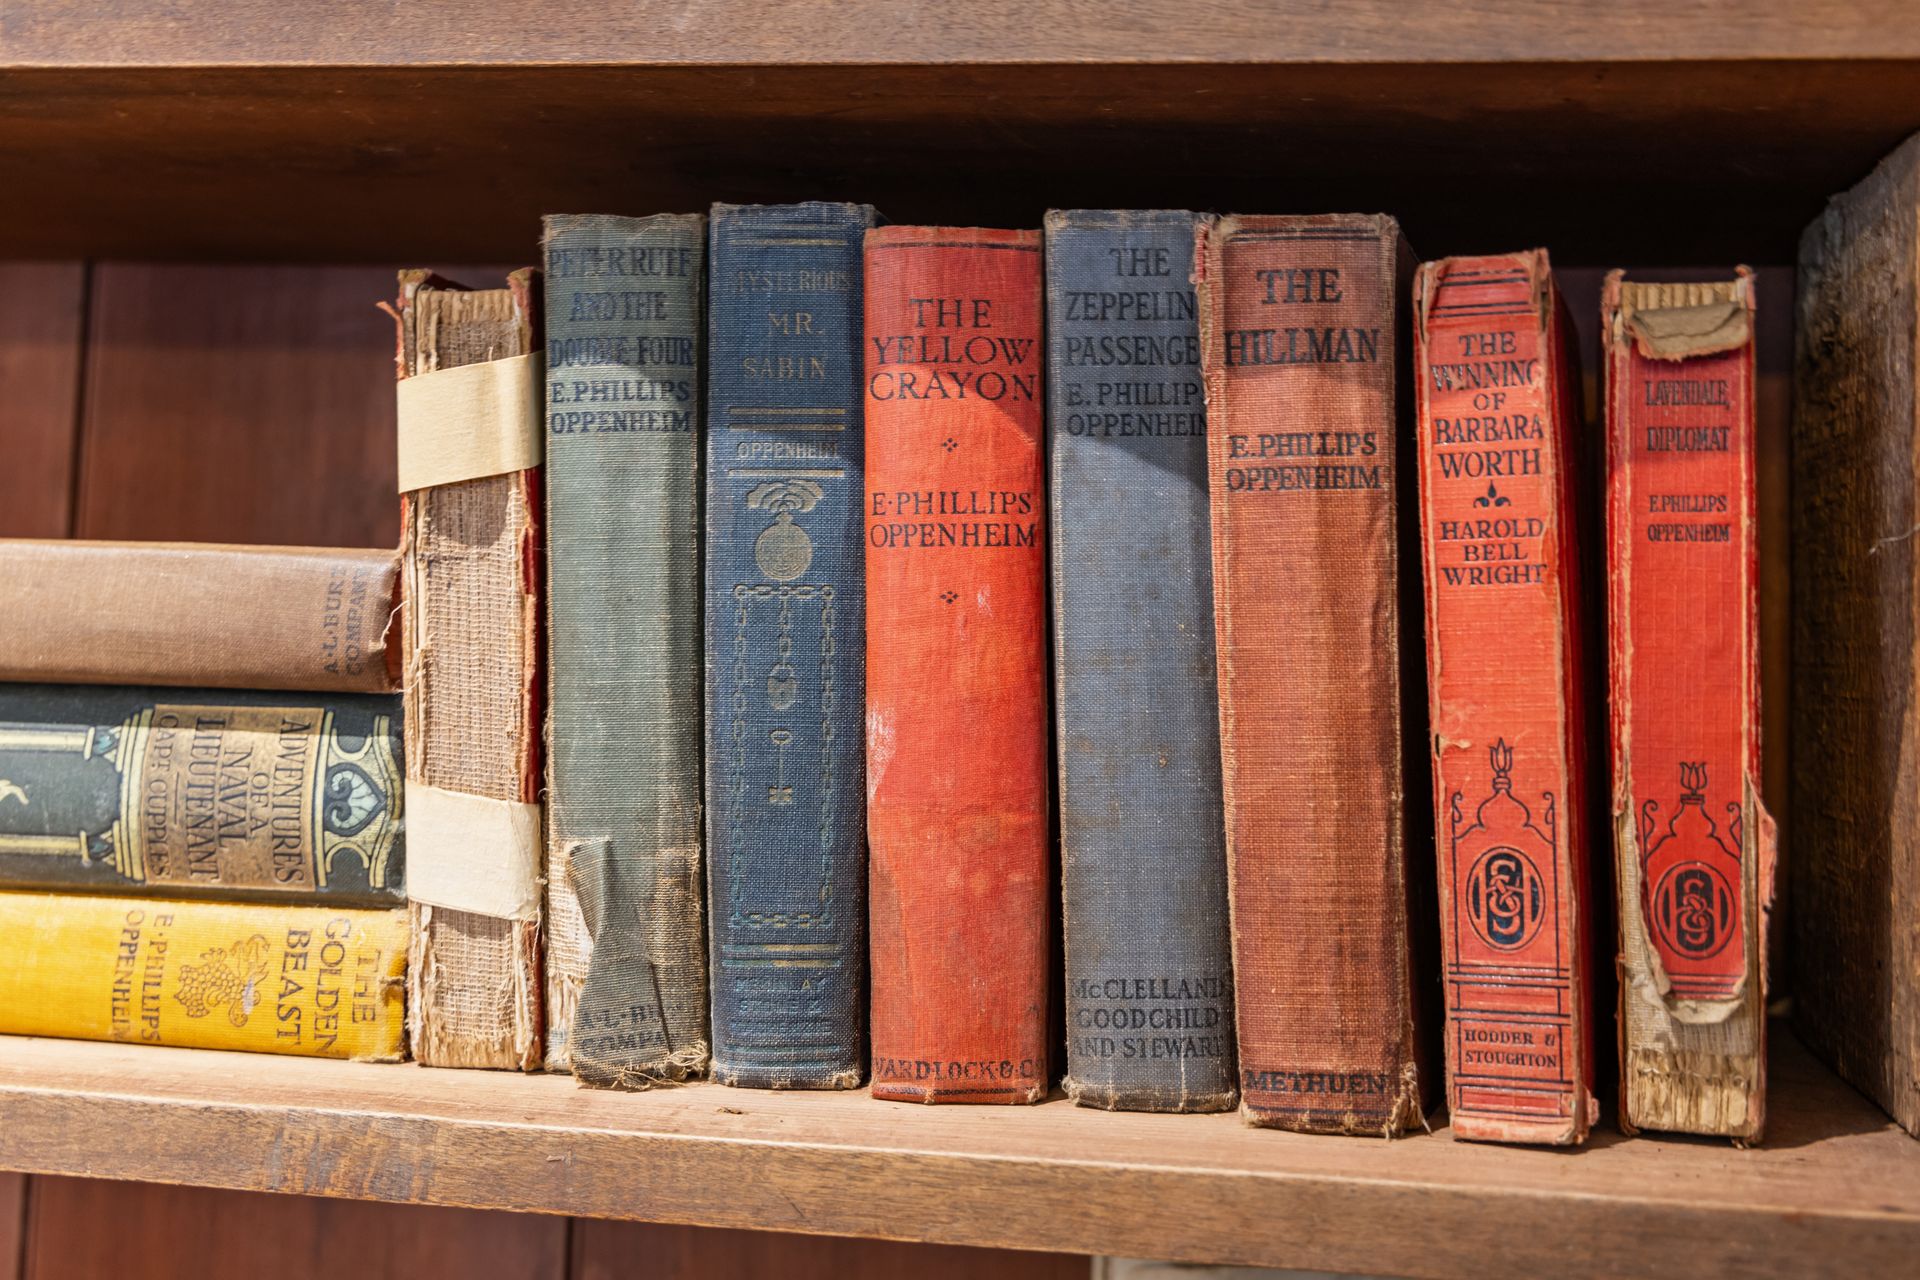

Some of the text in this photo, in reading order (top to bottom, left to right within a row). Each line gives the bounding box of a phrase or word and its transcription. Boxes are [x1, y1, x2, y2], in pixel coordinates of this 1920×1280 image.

[1109, 248, 1171, 277] THE
[1257, 269, 1343, 305] THE
[570, 292, 666, 321] AND THE
[909, 298, 992, 328] THE
[1065, 291, 1197, 321] ZEPPELIN
[872, 336, 1035, 365] YELLOW
[1064, 335, 1200, 366] PASSENGE
[1225, 328, 1381, 366] HILLMAN
[1458, 331, 1517, 356] THE
[743, 357, 826, 380] SABIN
[869, 371, 1036, 400] CRAYON
[1096, 382, 1202, 406] PHILLIP
[1473, 392, 1506, 411] OF
[551, 410, 691, 433] OPPENHEIM
[1434, 414, 1544, 444] BARBARA
[1647, 427, 1730, 451] DIPLOMAT
[1438, 448, 1543, 478] WORTH
[1226, 465, 1382, 491] OPPENHEIM
[870, 523, 1037, 548] OPPENHEIM
[1441, 518, 1544, 540] HAROLD
[1647, 524, 1730, 542] OPPENHEIM
[1464, 543, 1528, 562] BELL
[1442, 564, 1547, 586] WRIGHT
[186, 718, 226, 880] LIEUTENANT
[218, 747, 253, 848] NAVAL
[250, 772, 270, 835] OF A
[271, 718, 312, 883] ADVENTURES
[148, 779, 170, 876] CUPPLES
[277, 928, 312, 1045] BEAST
[314, 918, 351, 1052] GOLDEN
[352, 948, 381, 1023] THE
[1077, 1008, 1219, 1029] GOODCHILD
[1073, 1037, 1115, 1058] AND
[1464, 1029, 1534, 1045] HODDER
[1465, 1050, 1557, 1067] STOUGHTON
[1245, 1070, 1388, 1094] METHUEN
